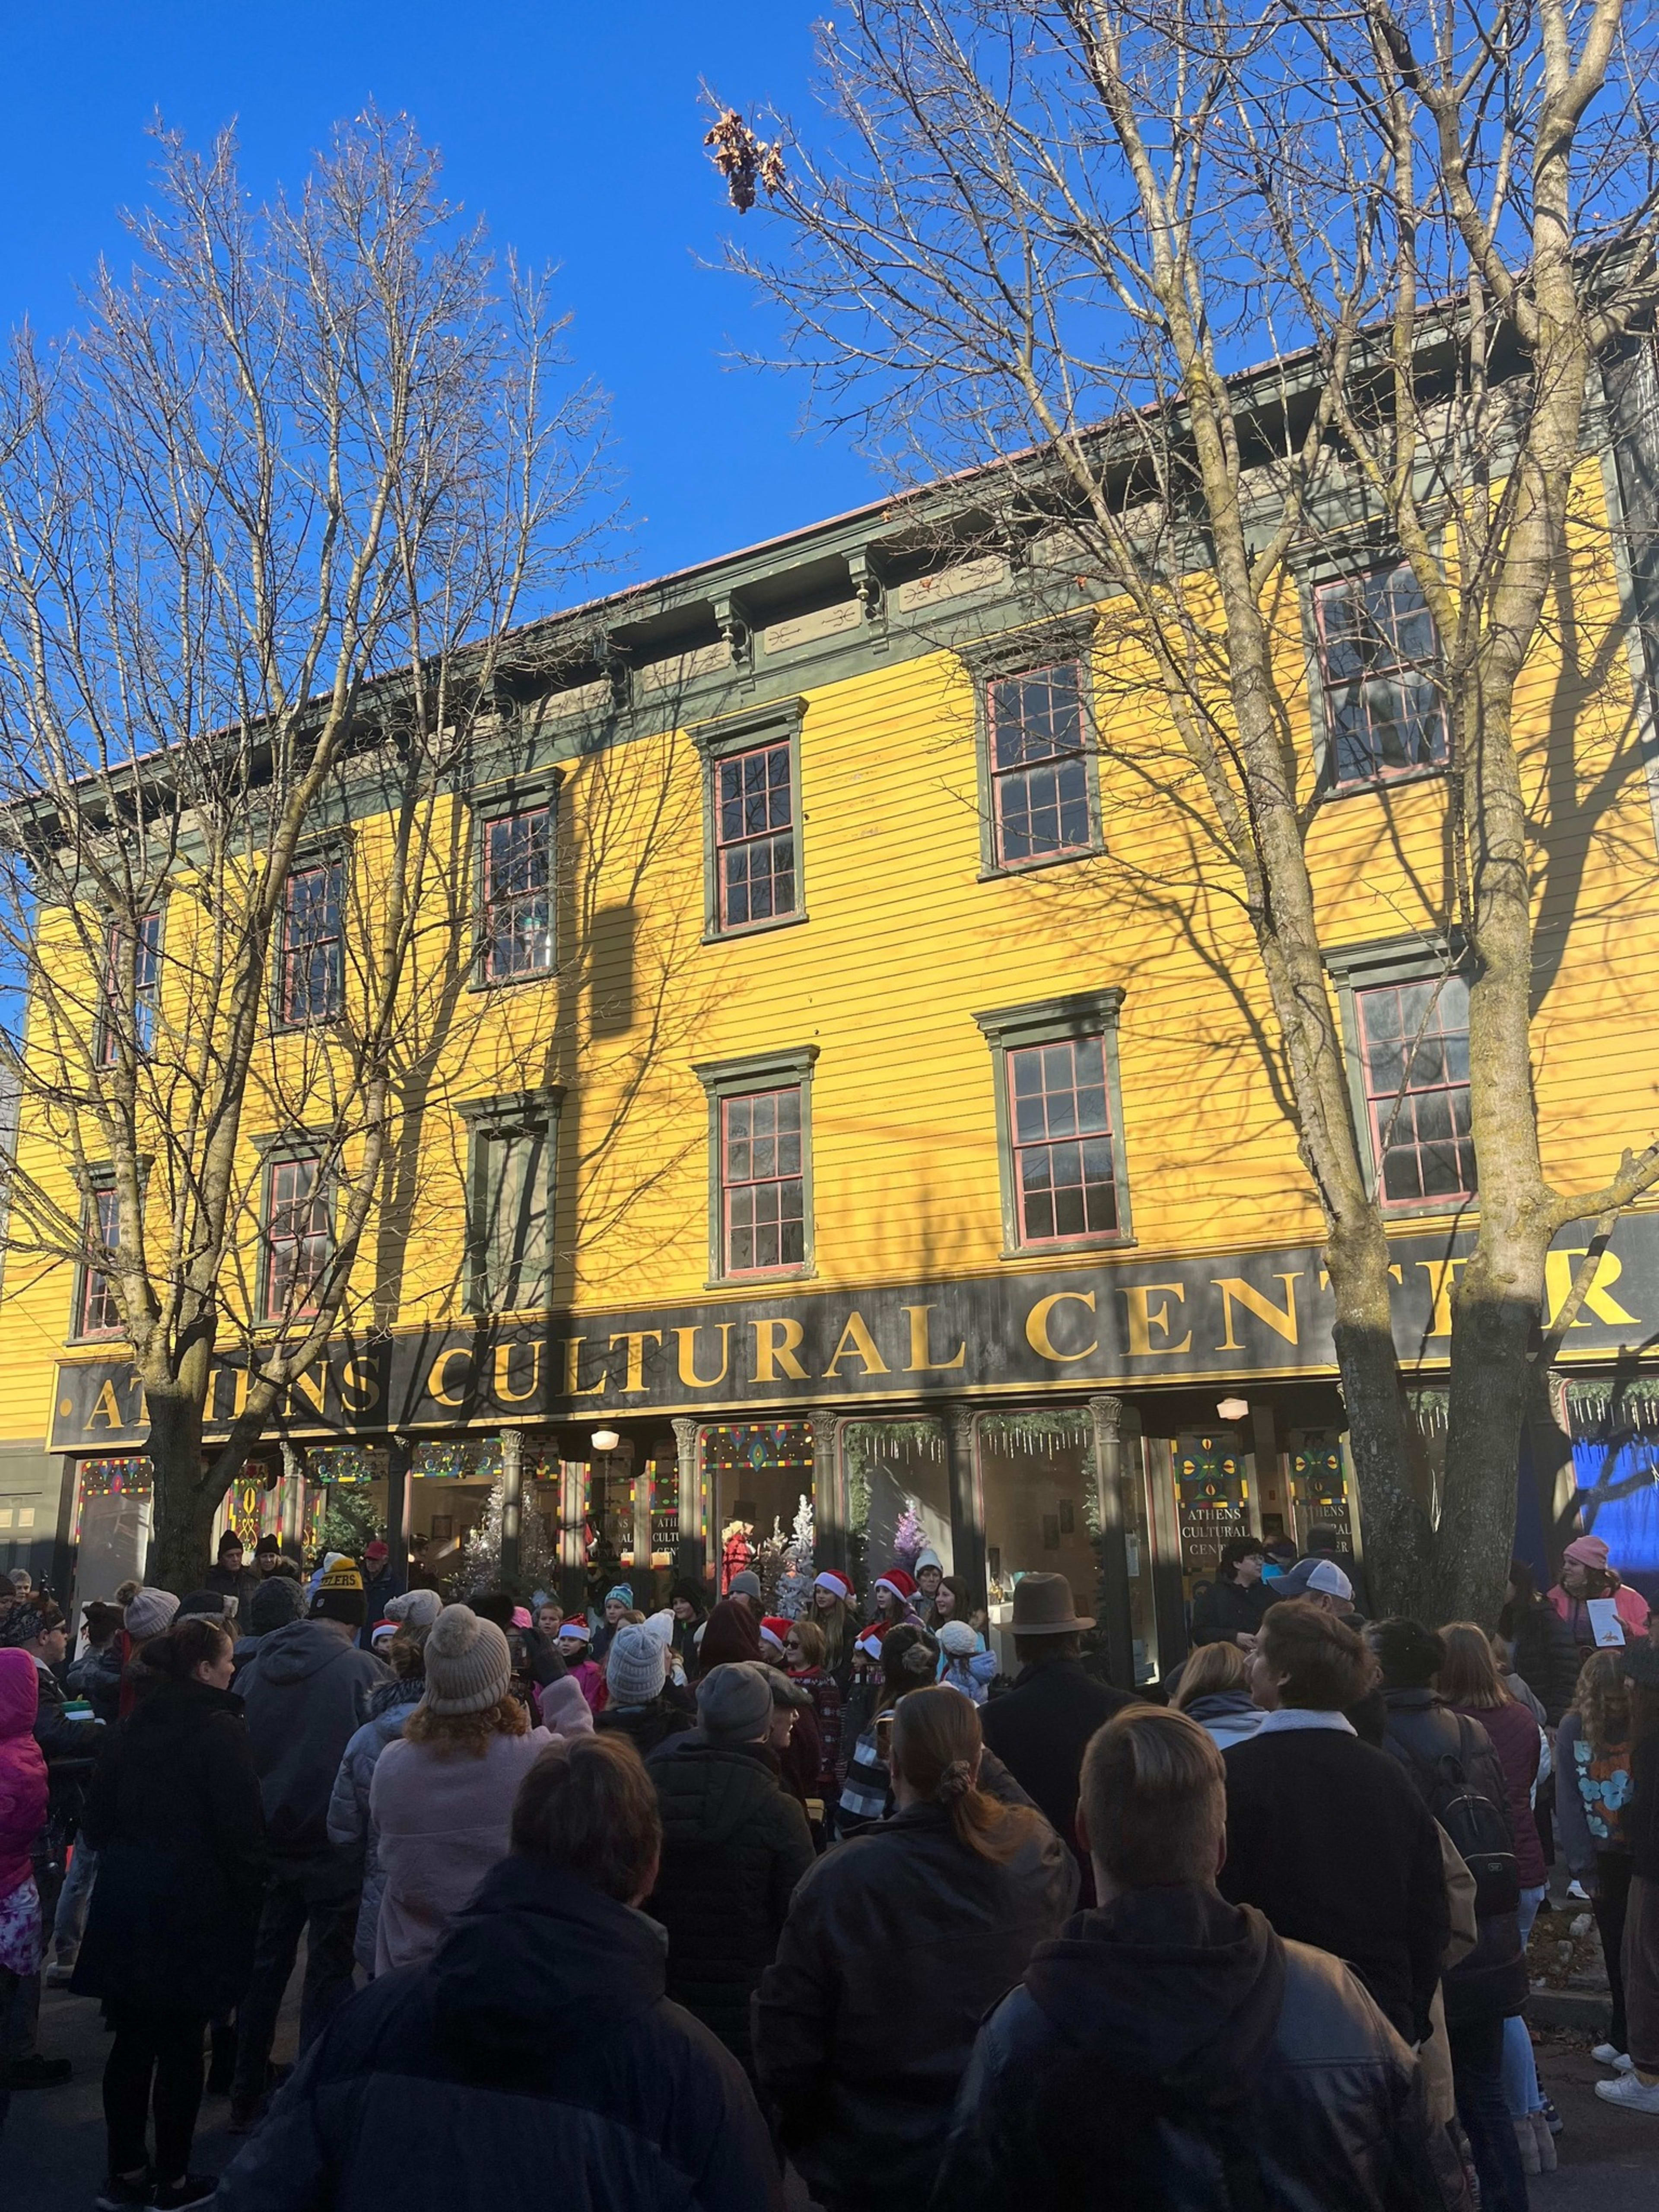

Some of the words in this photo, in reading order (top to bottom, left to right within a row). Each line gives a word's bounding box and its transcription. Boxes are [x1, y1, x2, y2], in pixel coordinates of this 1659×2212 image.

[428, 1305, 966, 1406] CULTURAL
[1026, 1248, 1641, 1362] CENER
[1188, 1508, 1241, 1520] ATHENS
[1182, 1526, 1250, 1538] CULTURAL
[1190, 1544, 1227, 1555] CENT
